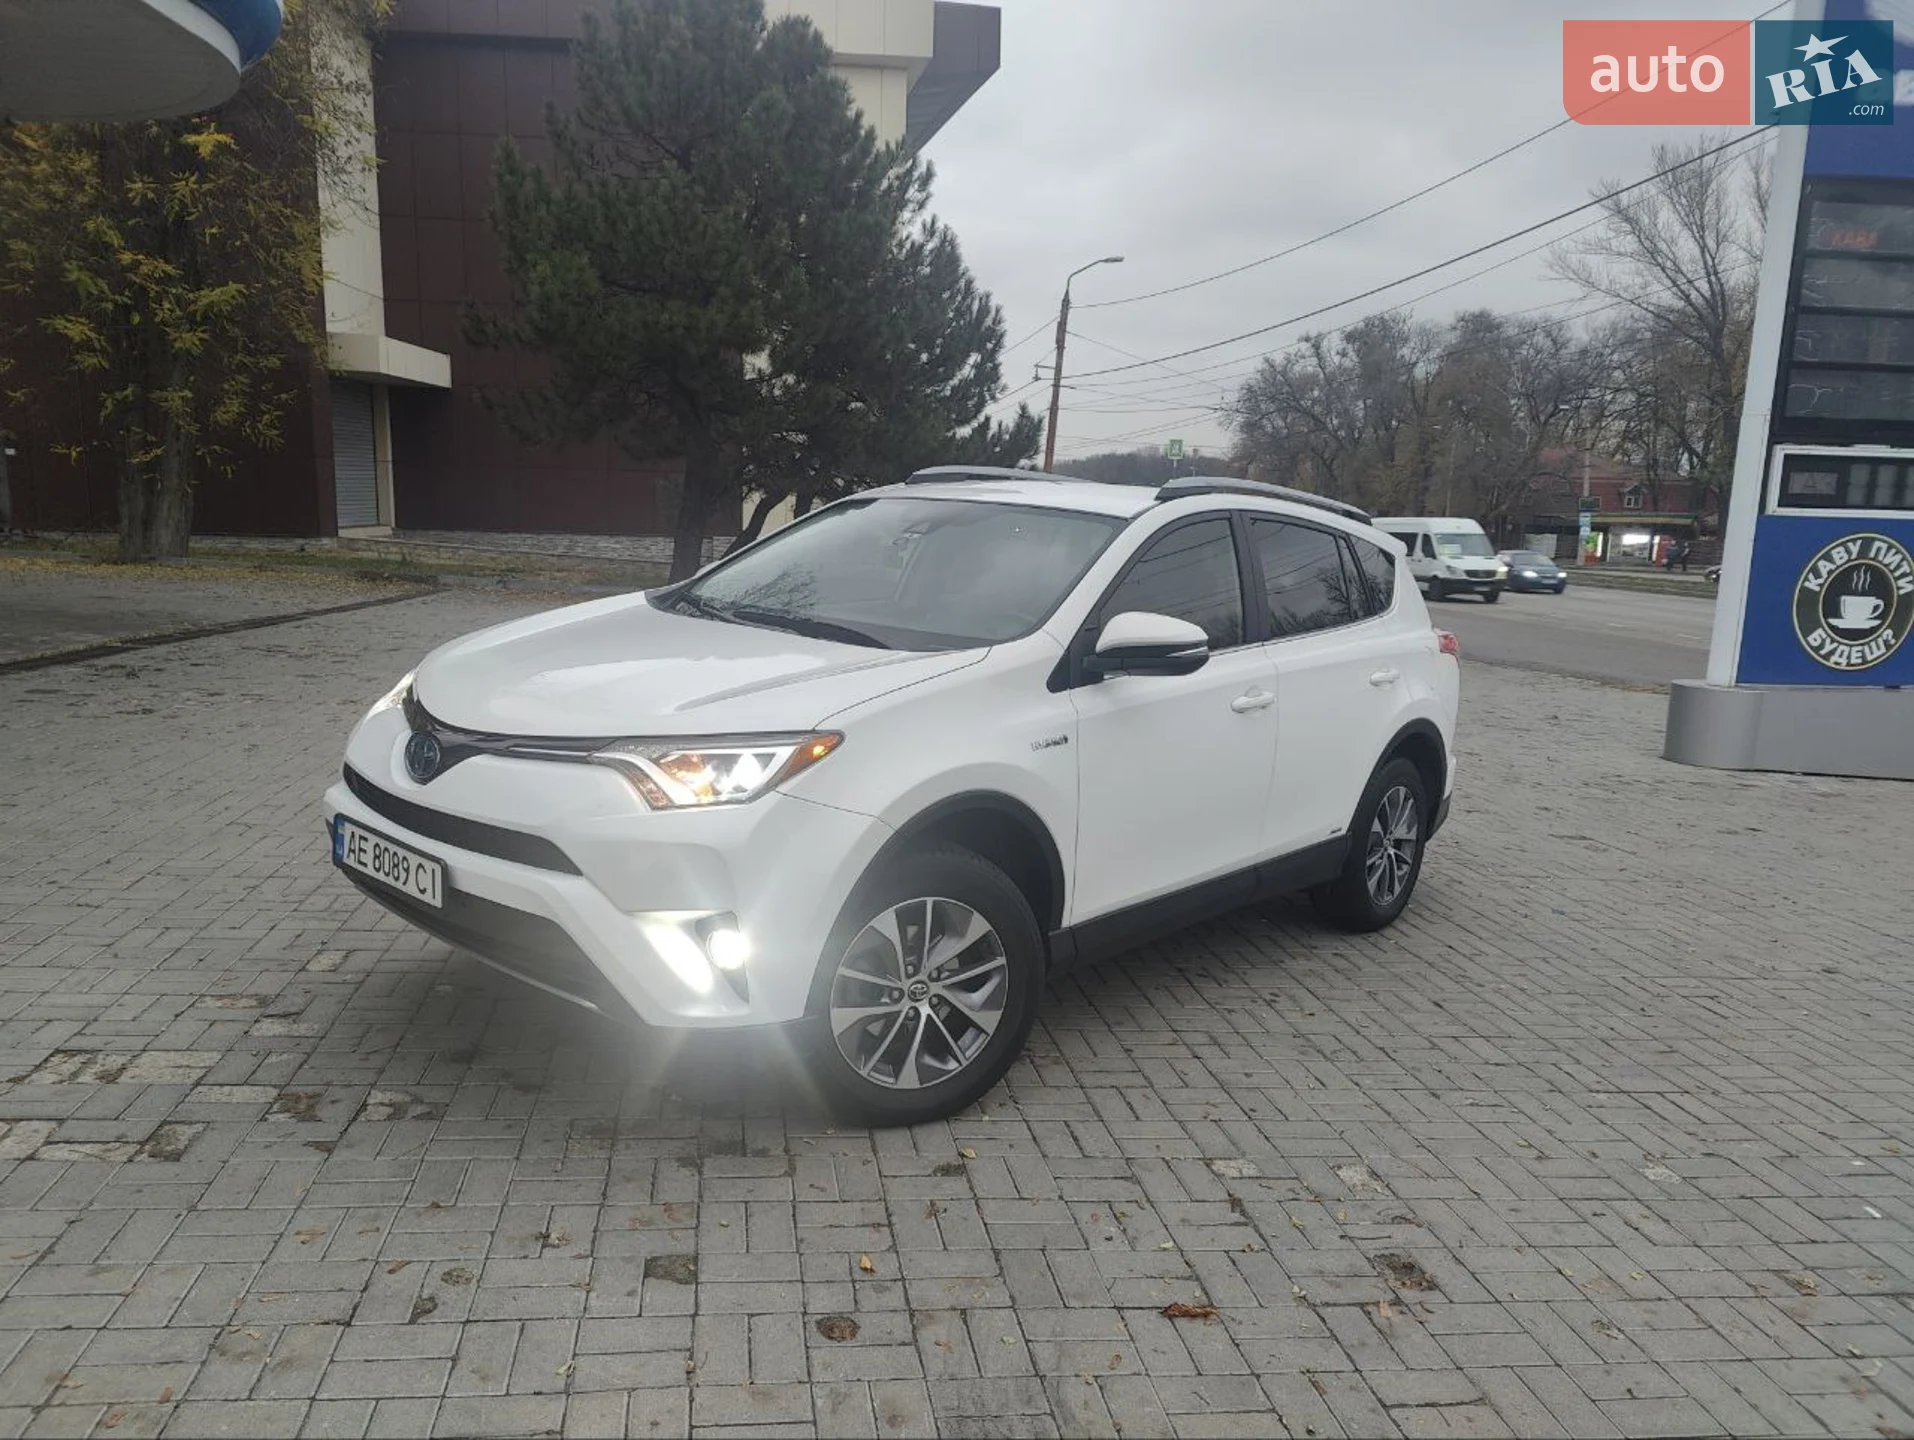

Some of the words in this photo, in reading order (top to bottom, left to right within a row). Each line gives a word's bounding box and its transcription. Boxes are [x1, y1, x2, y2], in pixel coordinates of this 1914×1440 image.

[1803, 539, 1863, 592] КАВУ
[1869, 540, 1914, 595] ПИТИ
[1806, 628, 1897, 667] БУДЕШ?
[346, 830, 369, 869] AE
[372, 842, 410, 886] 8089
[415, 862, 436, 900] CI
